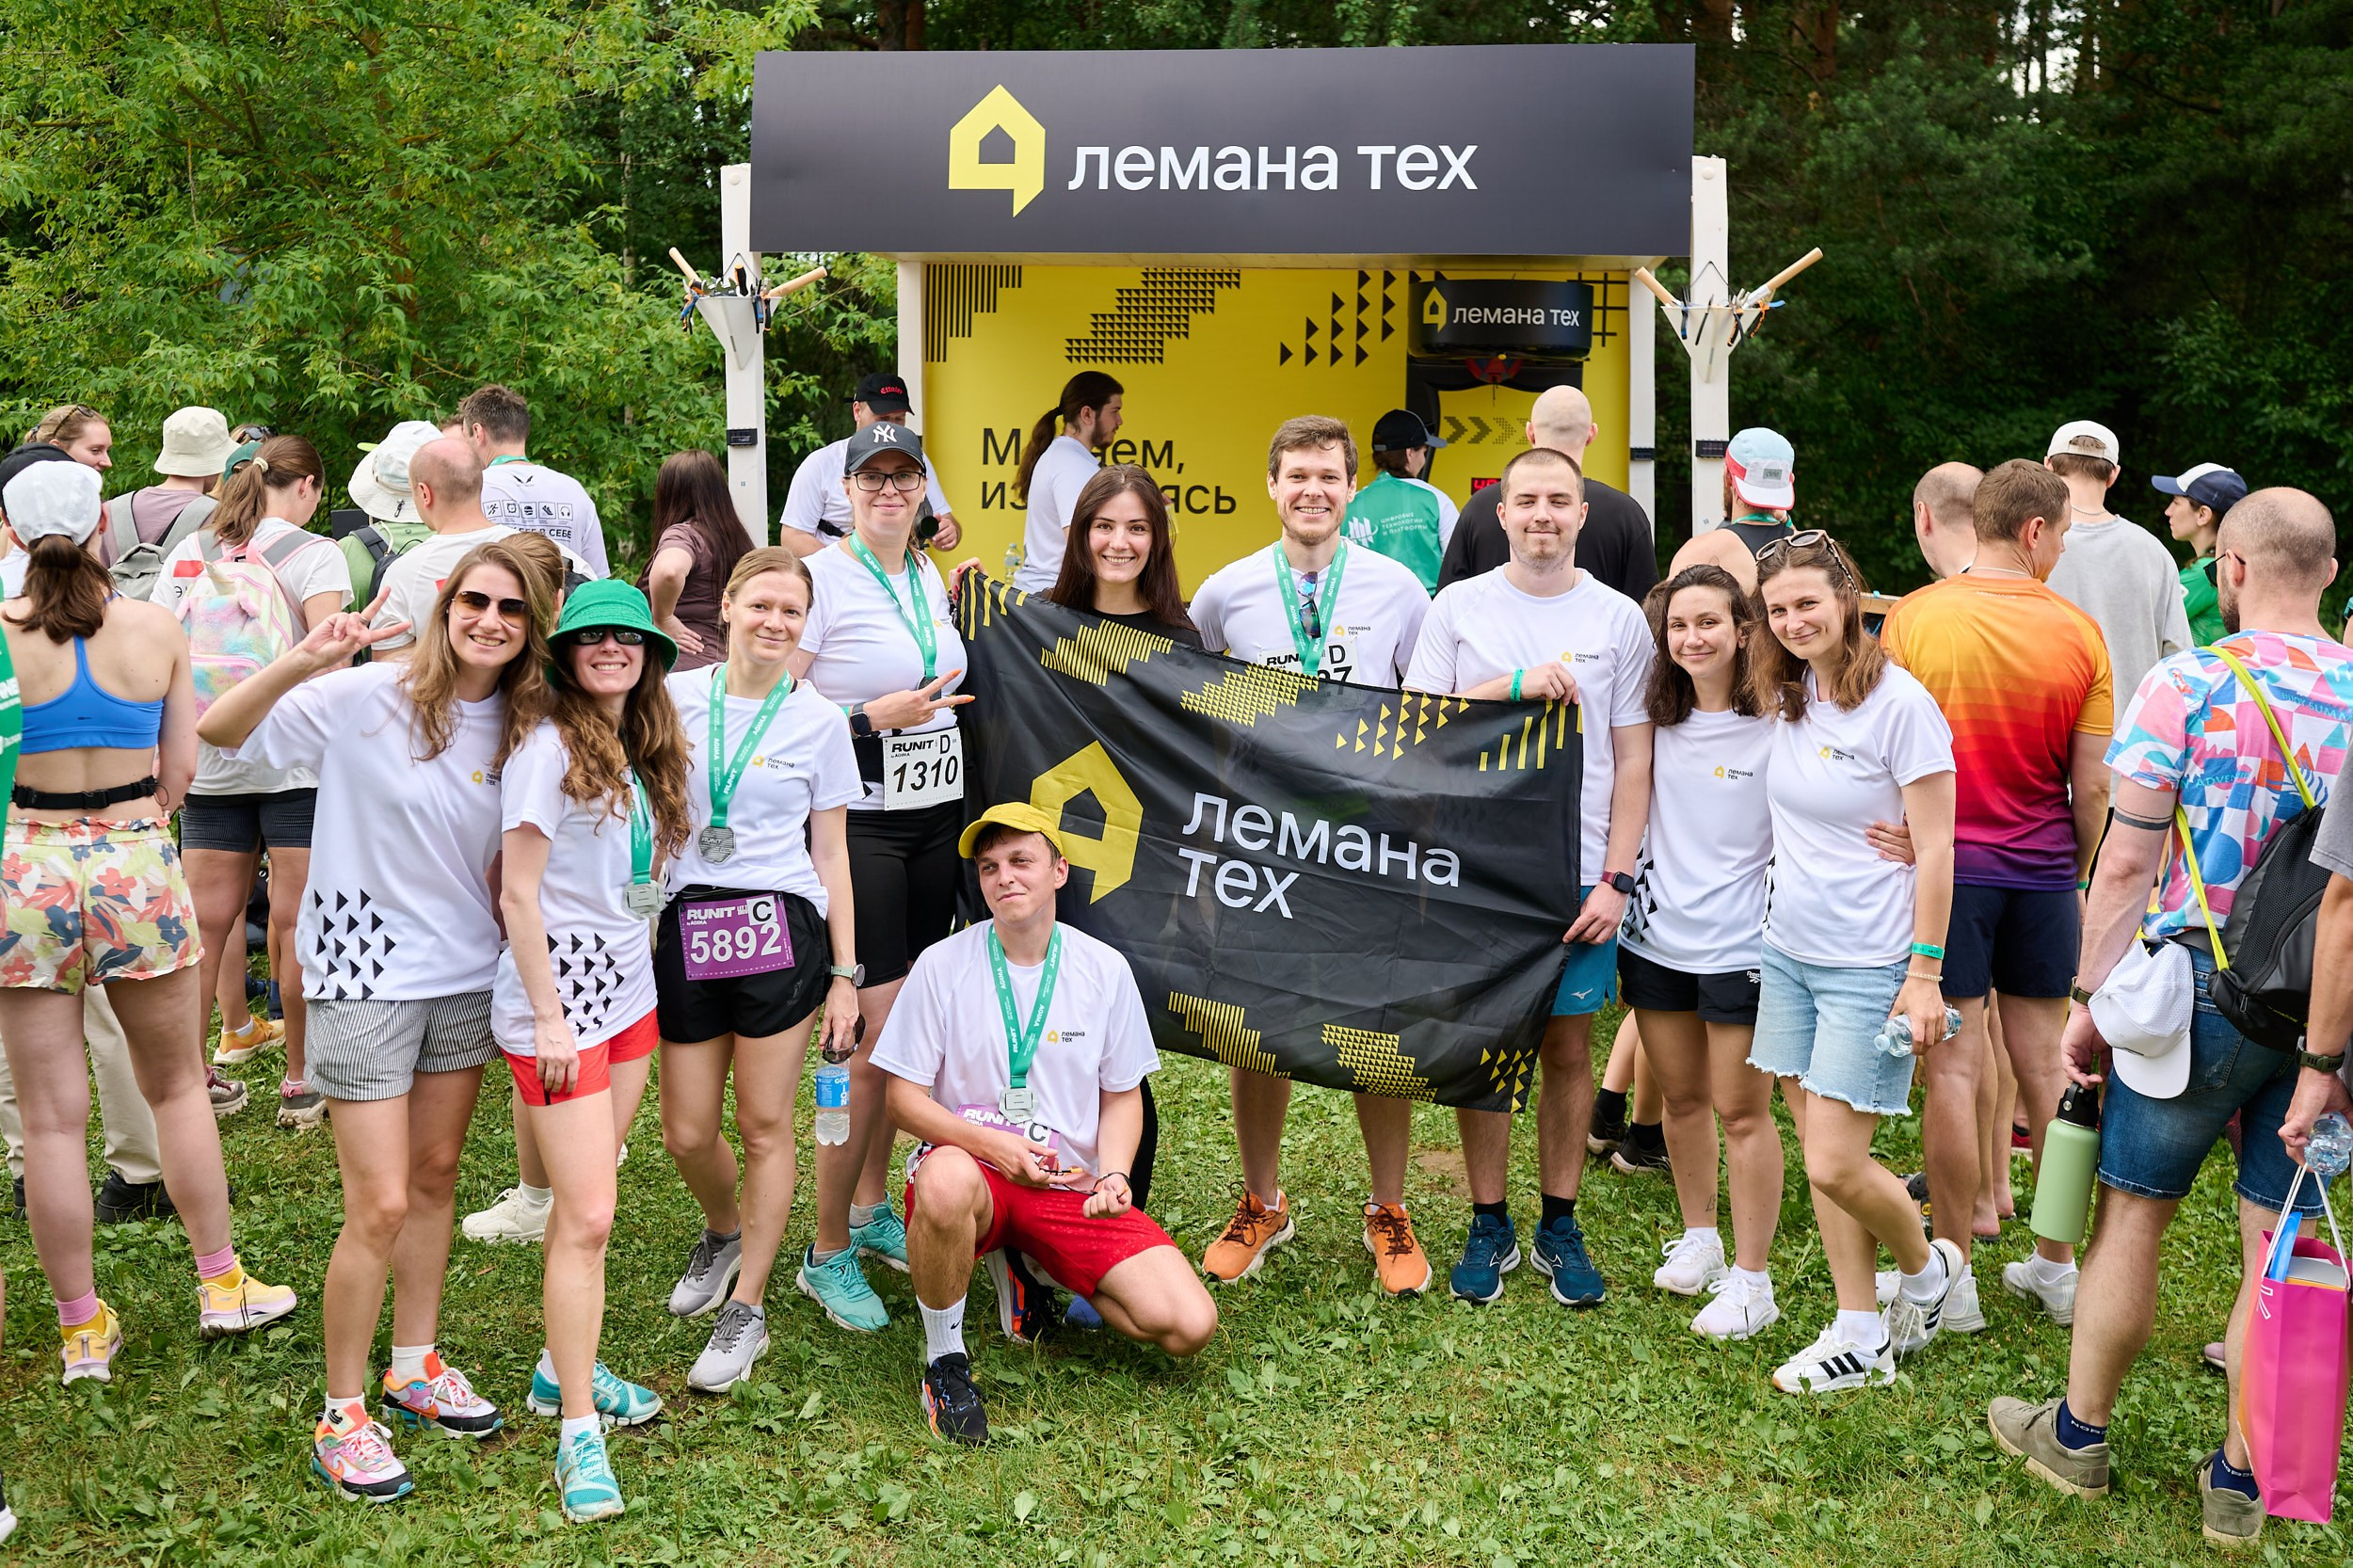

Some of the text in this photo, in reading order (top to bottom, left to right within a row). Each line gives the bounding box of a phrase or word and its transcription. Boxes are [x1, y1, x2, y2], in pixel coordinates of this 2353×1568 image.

[1067, 145, 1479, 190] лемана тех
[1452, 306, 1580, 328] лемана тех
[549, 528, 572, 539] СЕБЕ
[1382, 519, 1423, 530] ТЕХНОЛОГИИ
[1389, 524, 1429, 535] ПЛАТФОРМЫ
[863, 553, 881, 573] RUNIT
[1277, 553, 1287, 573] RUNIT
[1327, 577, 1337, 598] AGIMA
[1289, 604, 1298, 625] AGIMA
[923, 625, 933, 647] RUNIT
[1329, 644, 1346, 664] D
[713, 680, 723, 702] RUNIT
[753, 715, 768, 736] AGIMA
[891, 740, 935, 753] RUNIT
[939, 734, 951, 754] D
[767, 758, 795, 768] лемана
[1728, 768, 1753, 777] лемана
[723, 768, 738, 795] RUNIT
[892, 755, 958, 793] 1310
[1182, 792, 1461, 888] лемана
[1178, 847, 1301, 920] тех
[686, 905, 736, 920] RUNIT
[752, 901, 772, 922] C
[690, 921, 782, 964] 5892
[1049, 942, 1059, 968] RUNIT
[997, 966, 1007, 989] AGIMA
[1033, 1003, 1046, 1027] AGIMA
[1009, 1026, 1018, 1053] RUNIT
[1029, 1123, 1048, 1143] C
